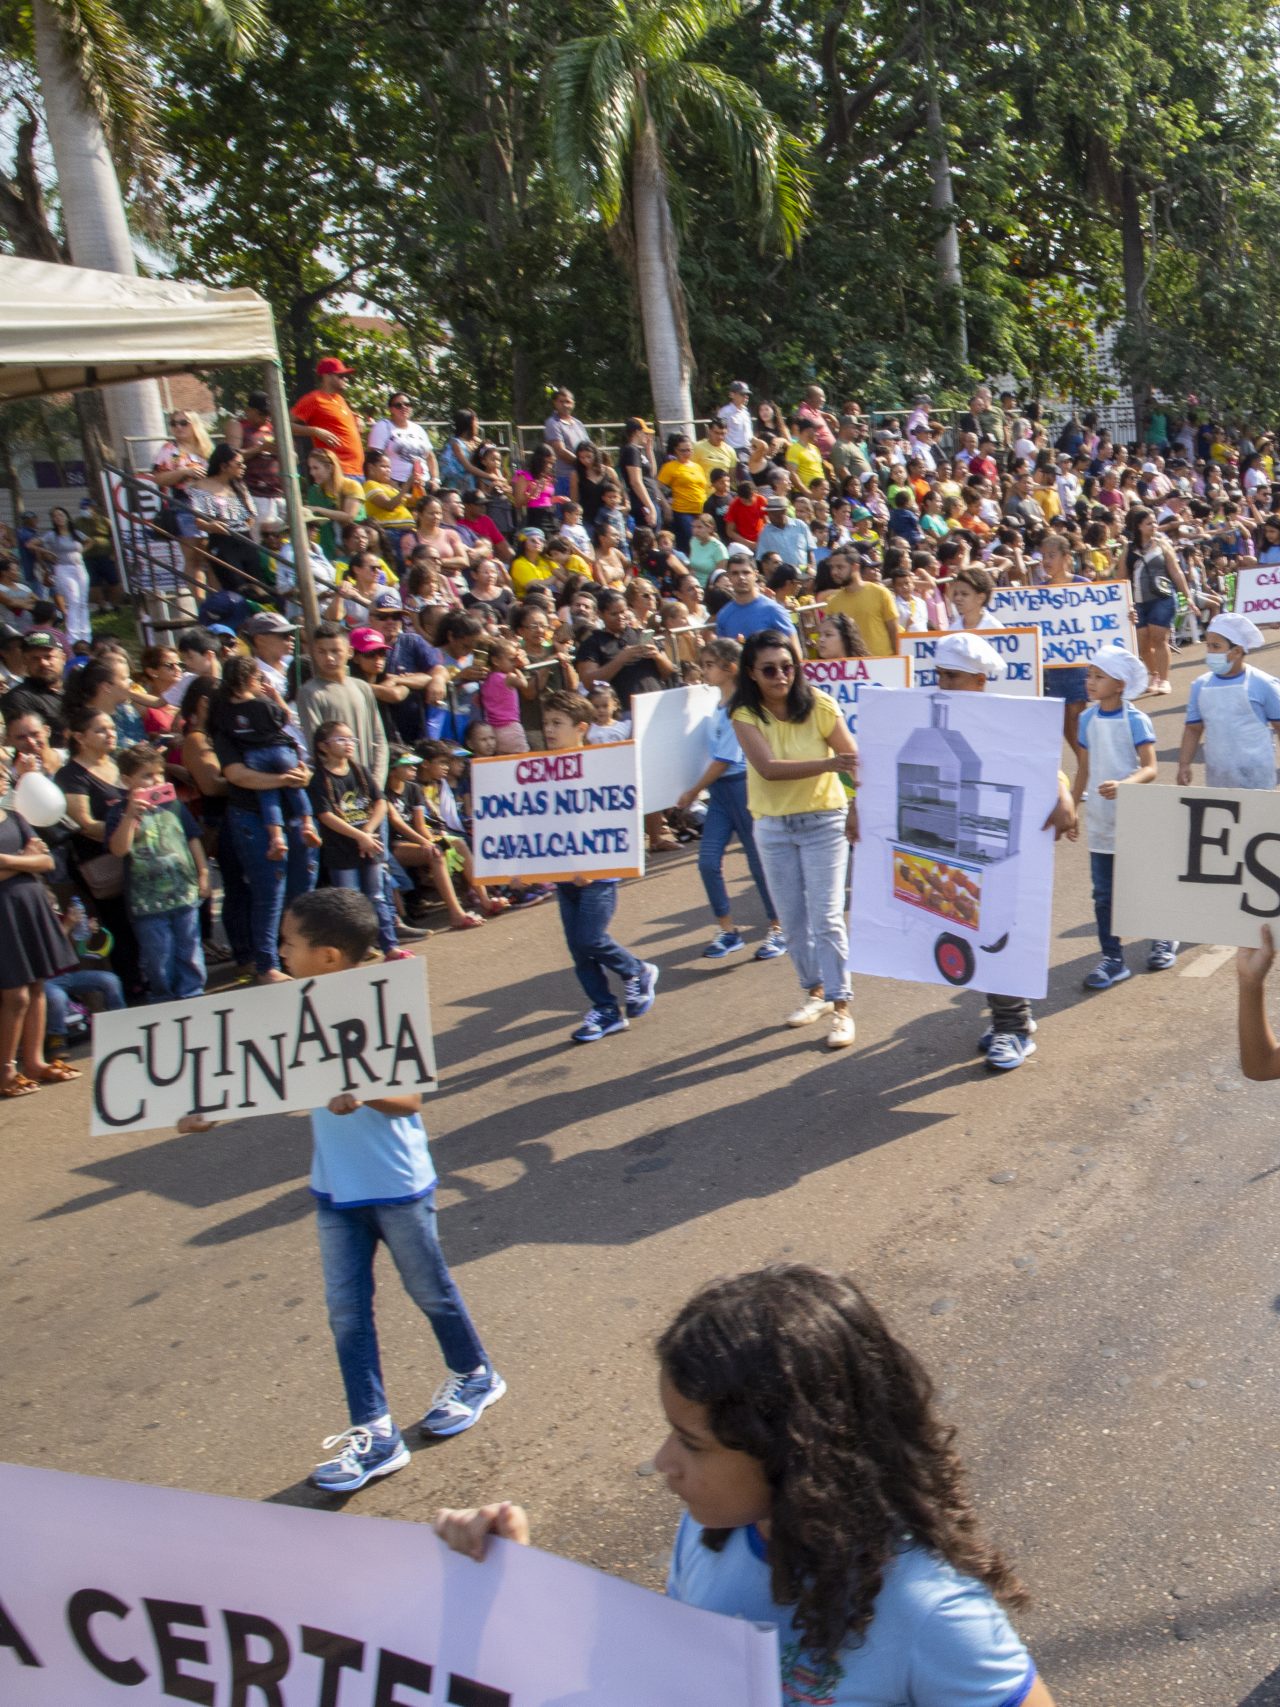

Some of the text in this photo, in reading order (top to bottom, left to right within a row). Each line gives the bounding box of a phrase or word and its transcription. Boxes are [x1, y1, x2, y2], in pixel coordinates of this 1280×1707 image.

[1090, 613, 1121, 632] DE
[803, 659, 870, 683] SCOLA
[1005, 661, 1033, 681] DE
[516, 753, 584, 786] CEMEI
[475, 784, 638, 820] JONAS NUNES
[481, 827, 629, 860] CAVALCANTE
[93, 979, 437, 1127] CULINÁRIA
[66, 1587, 513, 1707] CERTE
